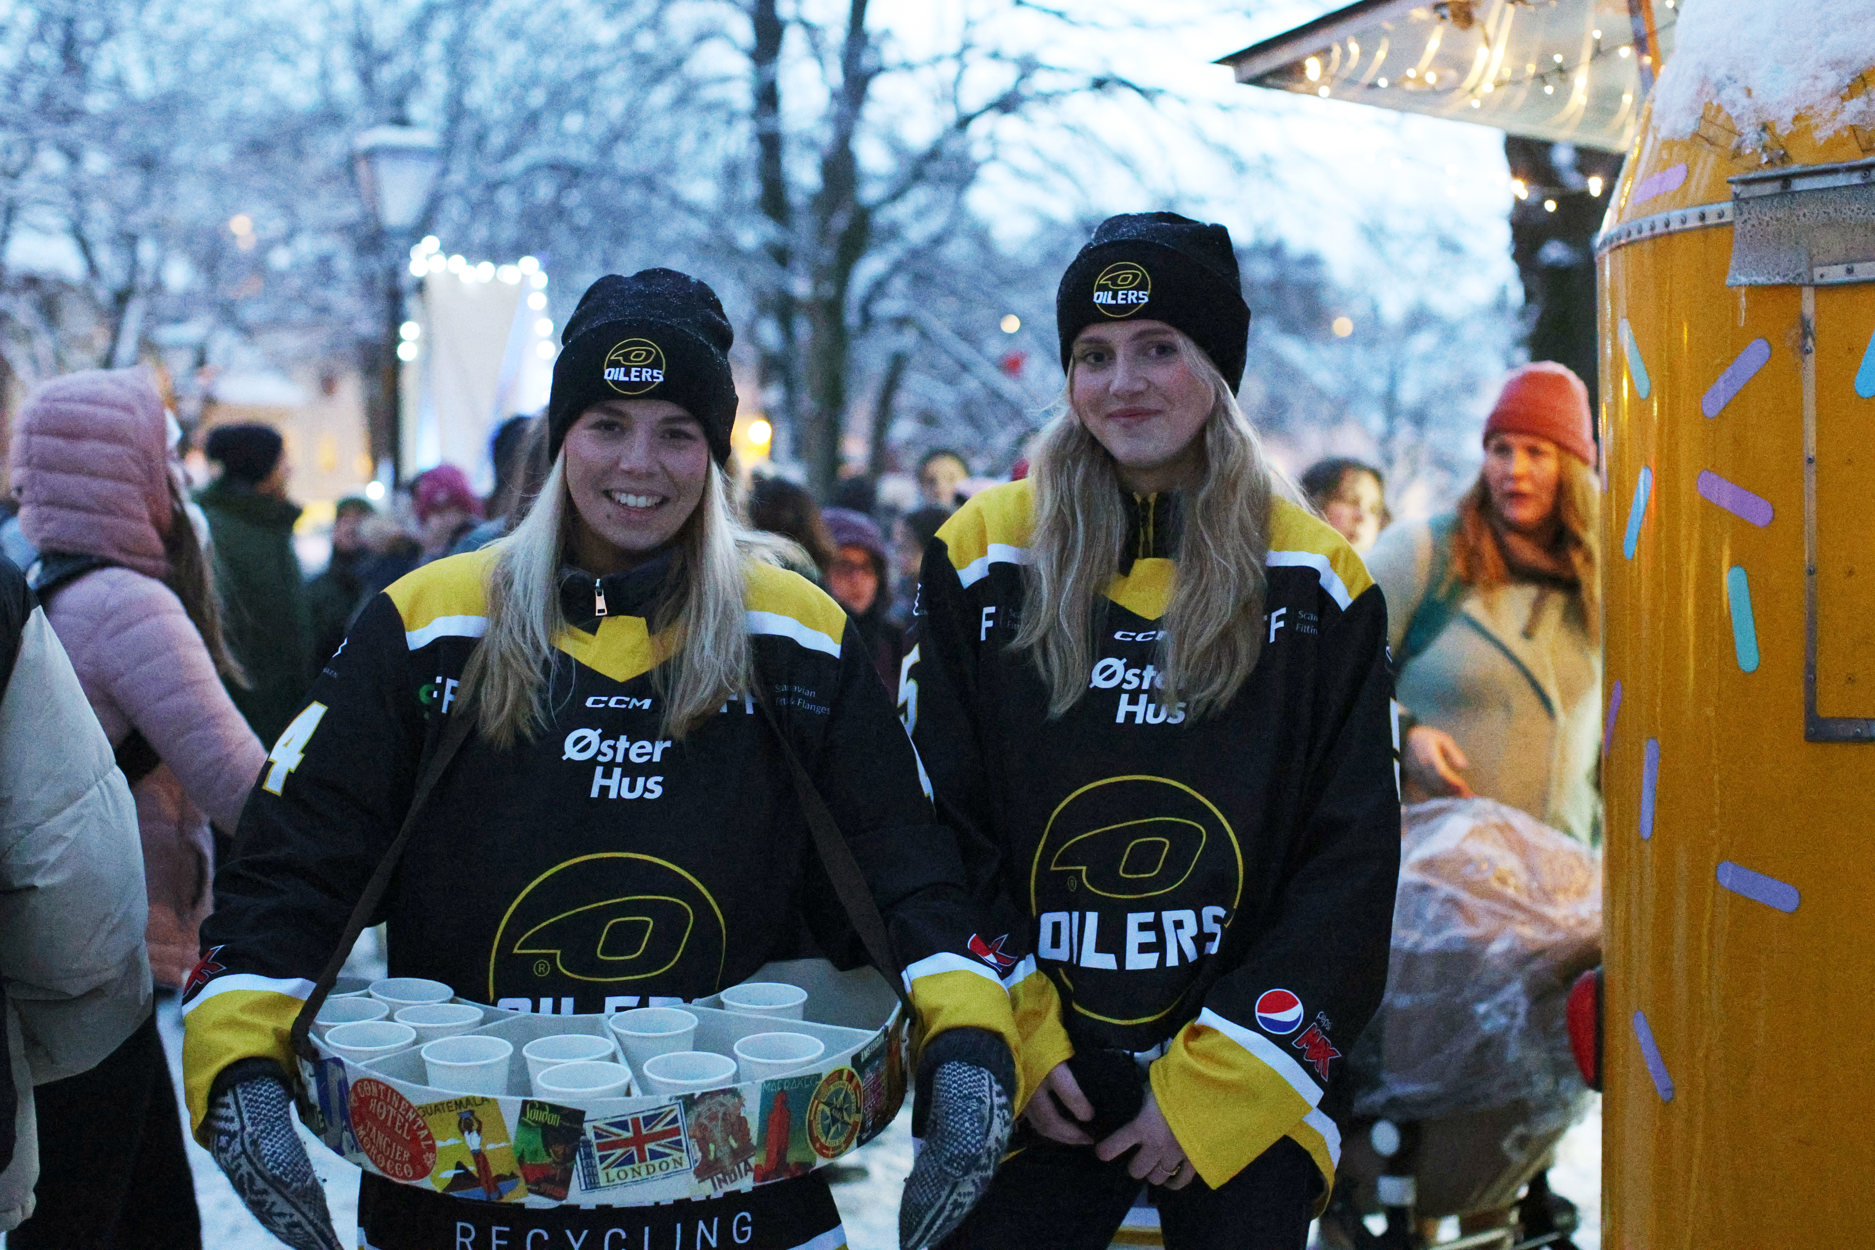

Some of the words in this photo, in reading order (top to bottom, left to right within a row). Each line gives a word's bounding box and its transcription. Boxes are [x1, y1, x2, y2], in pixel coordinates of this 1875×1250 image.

[1093, 290, 1149, 305] OILERS
[603, 367, 665, 382] OILERS
[1089, 657, 1167, 690] Øst
[585, 696, 652, 710] CCM
[1115, 693, 1187, 724] Hus
[261, 700, 329, 798] 4
[561, 727, 673, 764] Øster
[589, 765, 665, 800] Hus
[1037, 905, 1228, 971] OILERS
[356, 1080, 433, 1150] CONTINENTAL
[369, 1098, 411, 1141] HOTEL
[356, 1122, 414, 1179] MOROCCO
[365, 1119, 411, 1162] TANGIER
[605, 1156, 685, 1184] LONDON
[709, 1158, 754, 1192] INDIA
